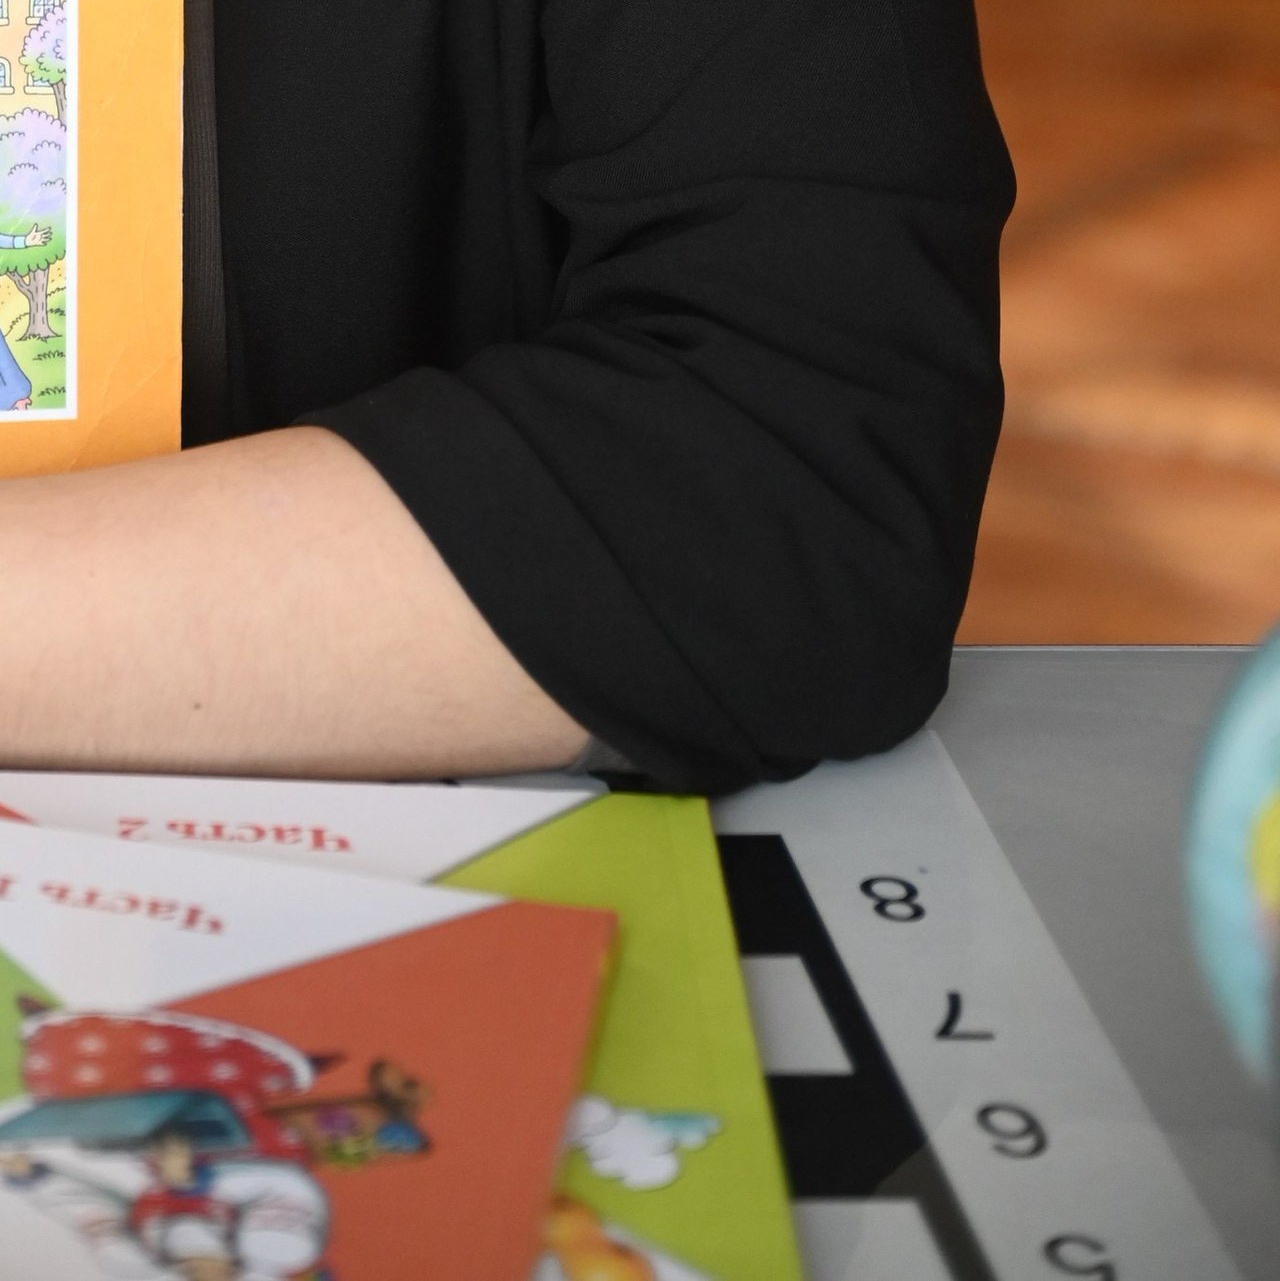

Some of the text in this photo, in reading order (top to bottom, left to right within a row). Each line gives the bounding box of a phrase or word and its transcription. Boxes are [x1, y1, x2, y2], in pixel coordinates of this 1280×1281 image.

[117, 816, 352, 853] Часть 2
[39, 880, 223, 935] Часть
[860, 875, 925, 923] 8
[934, 990, 995, 1041] 7
